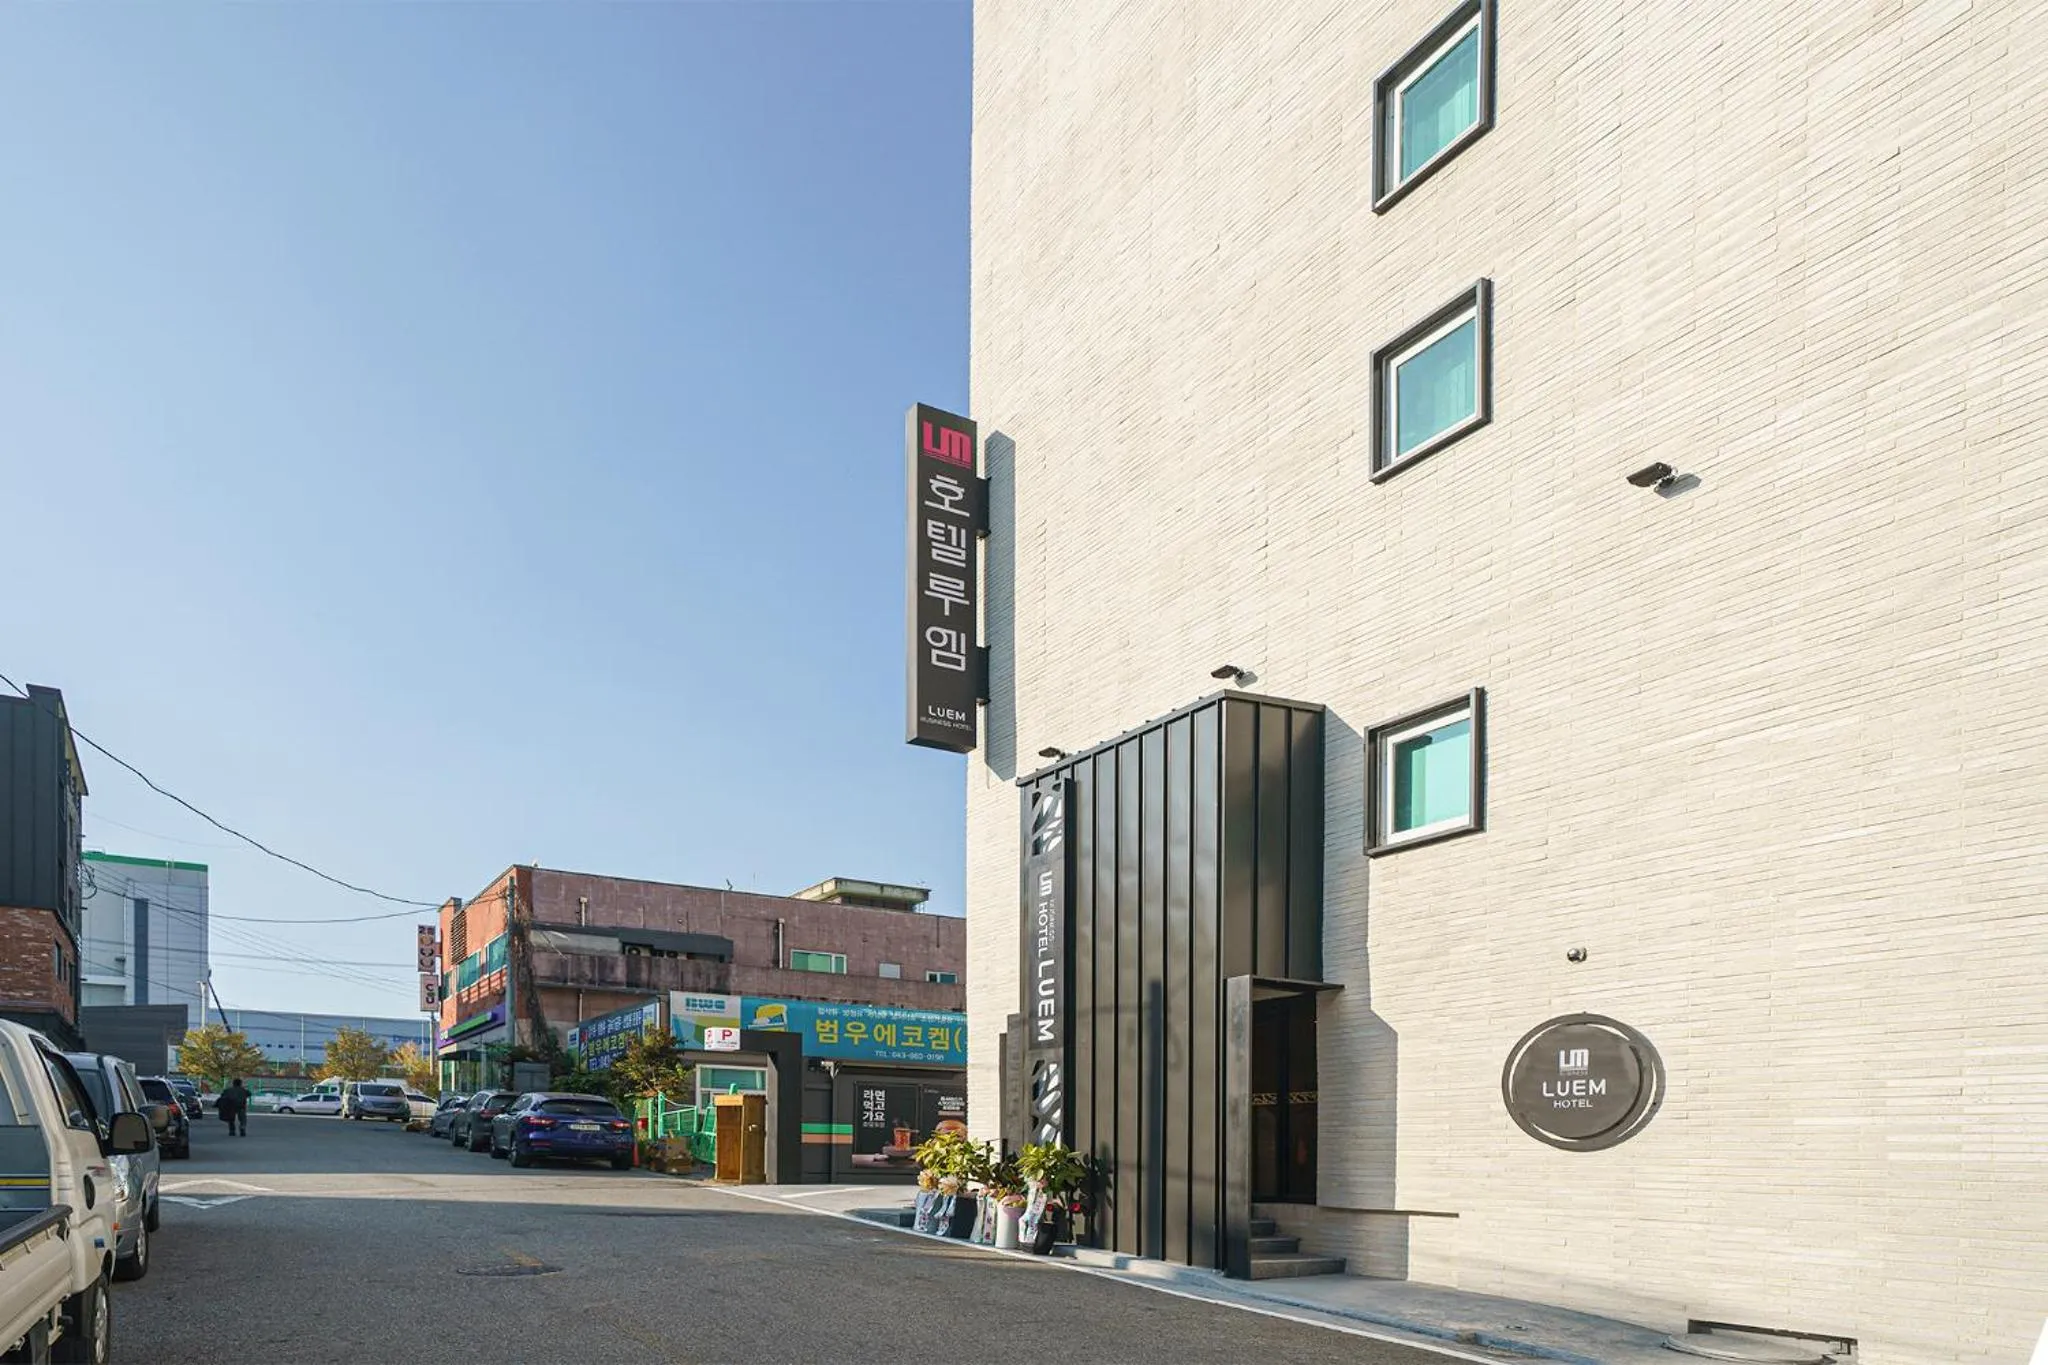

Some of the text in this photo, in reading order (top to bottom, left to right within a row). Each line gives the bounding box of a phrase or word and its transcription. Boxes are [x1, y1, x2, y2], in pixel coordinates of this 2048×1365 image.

[928, 704, 966, 722] LUEM
[1038, 902, 1049, 958] HOTEL
[1037, 959, 1055, 1042] LUEM
[722, 1030, 733, 1040] P
[1542, 1078, 1607, 1097] LUEM
[863, 1089, 886, 1101] 라면
[863, 1101, 886, 1111] 먹고
[1553, 1099, 1593, 1108] HOTEL
[862, 1111, 886, 1122] 가요
